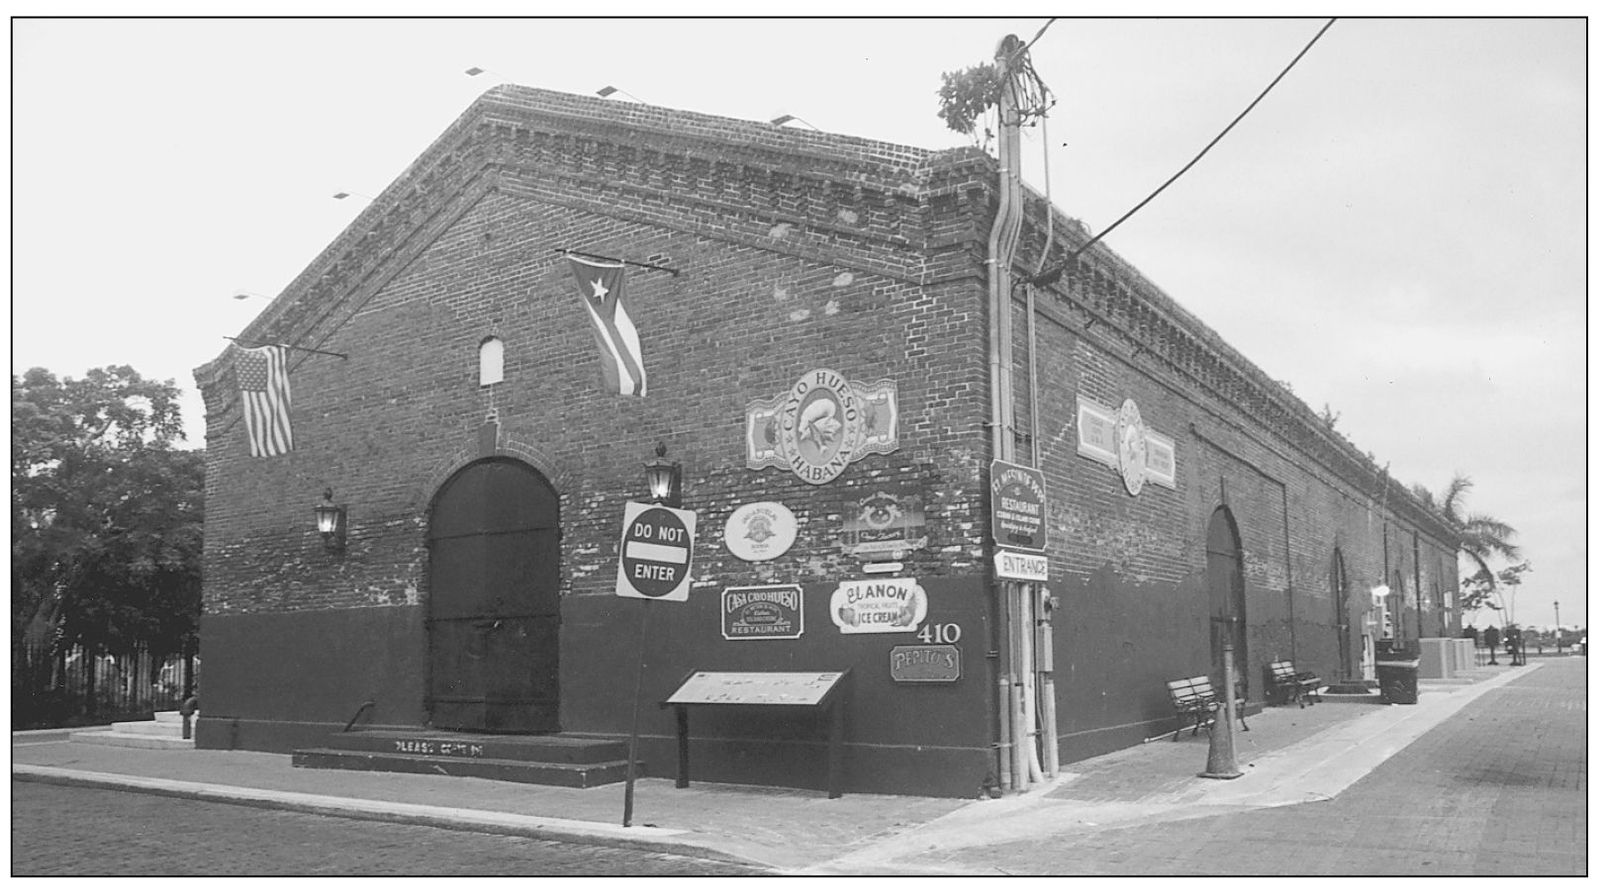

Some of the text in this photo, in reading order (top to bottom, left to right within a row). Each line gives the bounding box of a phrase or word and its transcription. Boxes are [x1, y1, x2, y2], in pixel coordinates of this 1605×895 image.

[783, 372, 857, 431] CAYO HUESO
[792, 451, 850, 481] HABANA
[634, 523, 684, 542] DO NOT
[634, 563, 675, 581] ENTER
[1002, 555, 1047, 576] ENTRANCE
[727, 593, 747, 613] CASA
[767, 591, 798, 611] HUESO
[865, 584, 908, 601] ANON
[858, 611, 898, 624] ICE CREAM
[731, 625, 792, 634] RESTAURANT
[916, 623, 962, 643] 410
